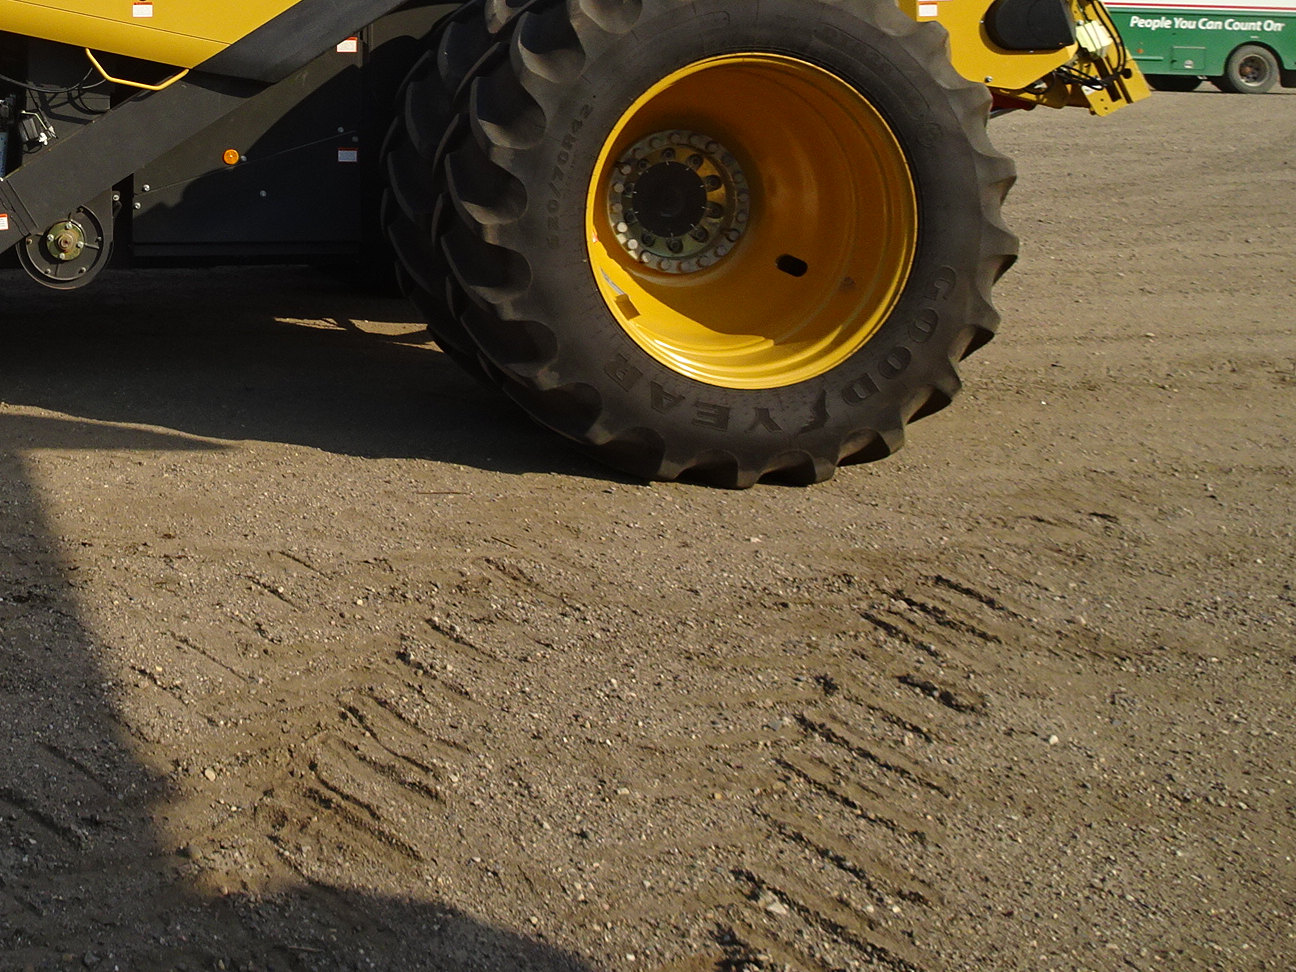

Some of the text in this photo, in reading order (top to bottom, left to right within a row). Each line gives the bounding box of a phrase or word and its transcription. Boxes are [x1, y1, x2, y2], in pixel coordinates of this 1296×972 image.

[1129, 15, 1173, 30] People
[1173, 17, 1197, 29] You
[1197, 18, 1222, 30] Can
[1224, 19, 1262, 31] Count
[605, 264, 957, 433] GOODYEAR
